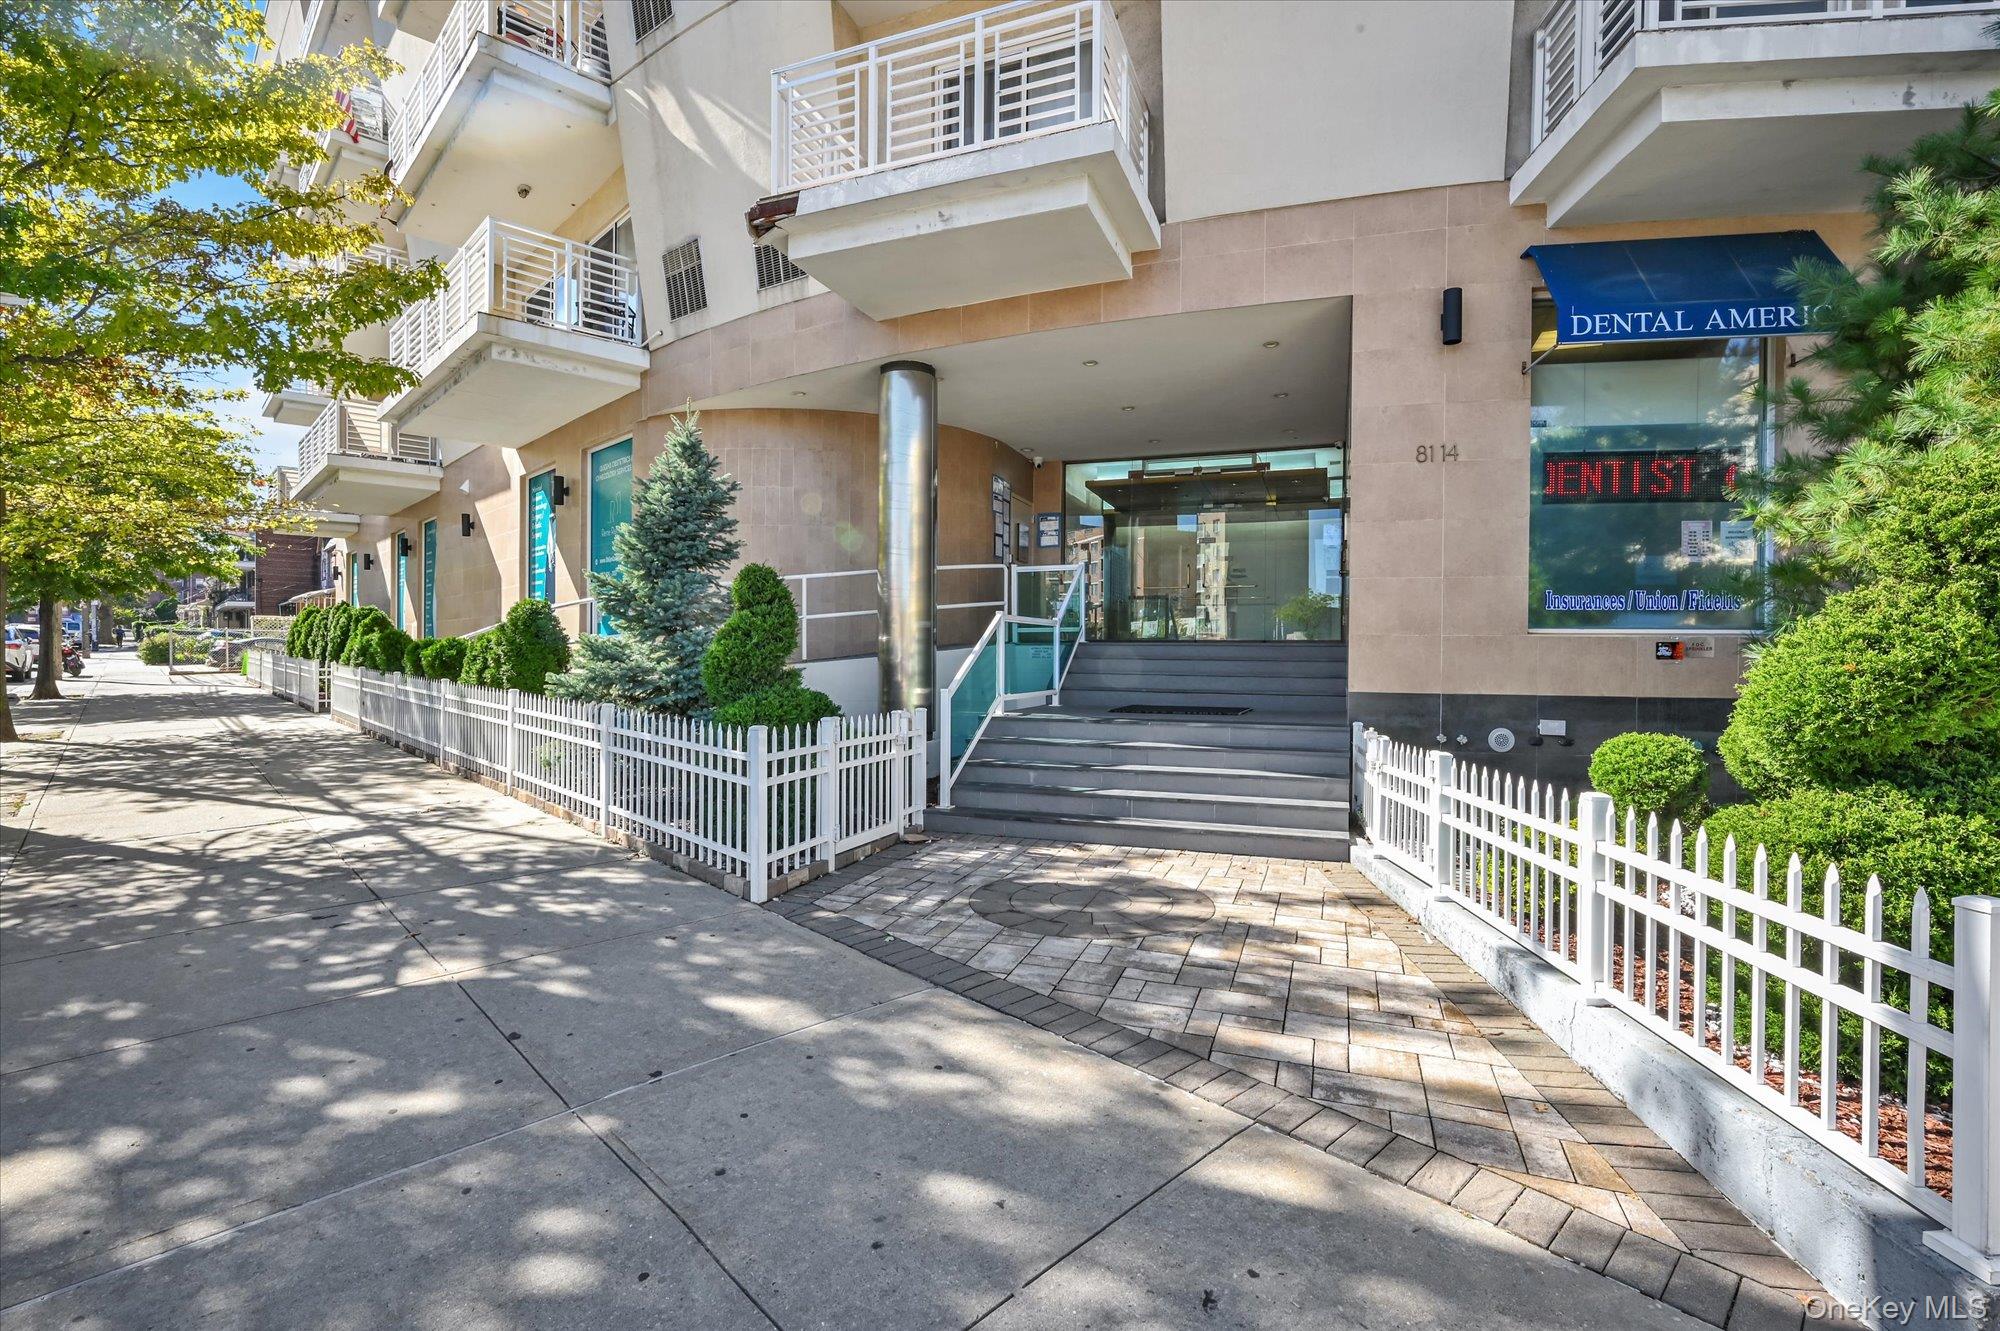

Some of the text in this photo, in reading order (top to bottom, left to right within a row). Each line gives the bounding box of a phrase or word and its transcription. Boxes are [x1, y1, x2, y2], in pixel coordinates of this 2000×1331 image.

[1570, 304, 1849, 336] DENTAL AMERIC
[1415, 444, 1460, 463] 8114
[1545, 589, 1626, 611] Insurances
[1635, 589, 1679, 611] Union
